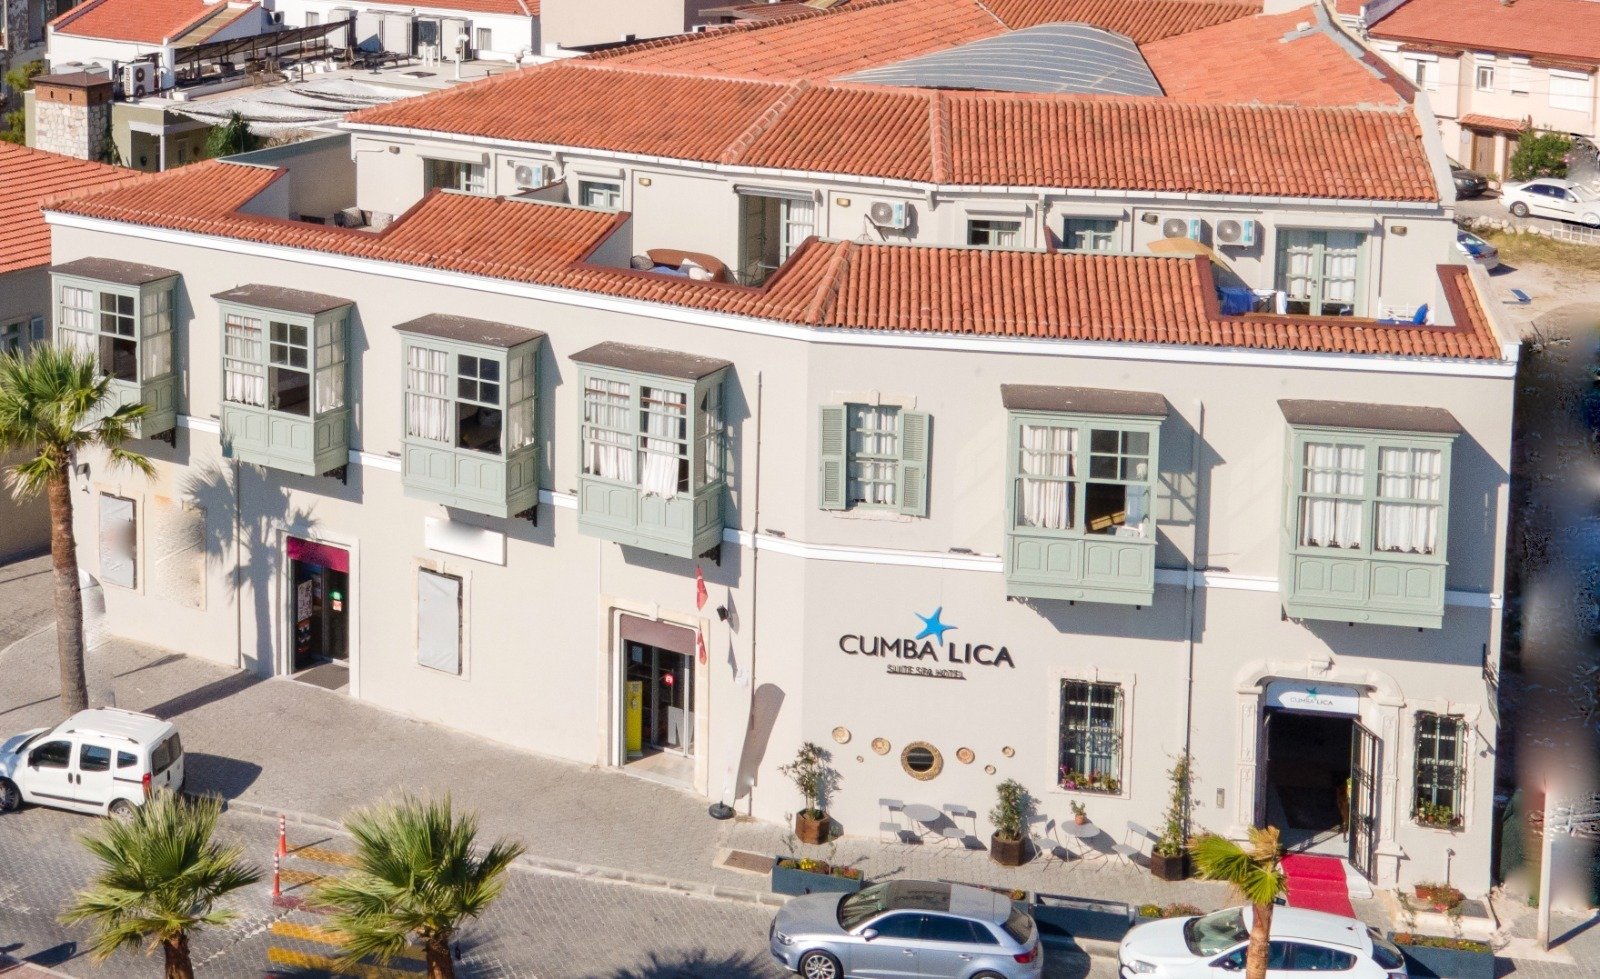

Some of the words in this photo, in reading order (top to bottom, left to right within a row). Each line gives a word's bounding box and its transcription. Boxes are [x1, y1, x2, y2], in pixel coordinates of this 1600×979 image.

[839, 634, 939, 662] CUMBA
[949, 642, 1016, 669] LICA
[887, 664, 914, 674] SUITE
